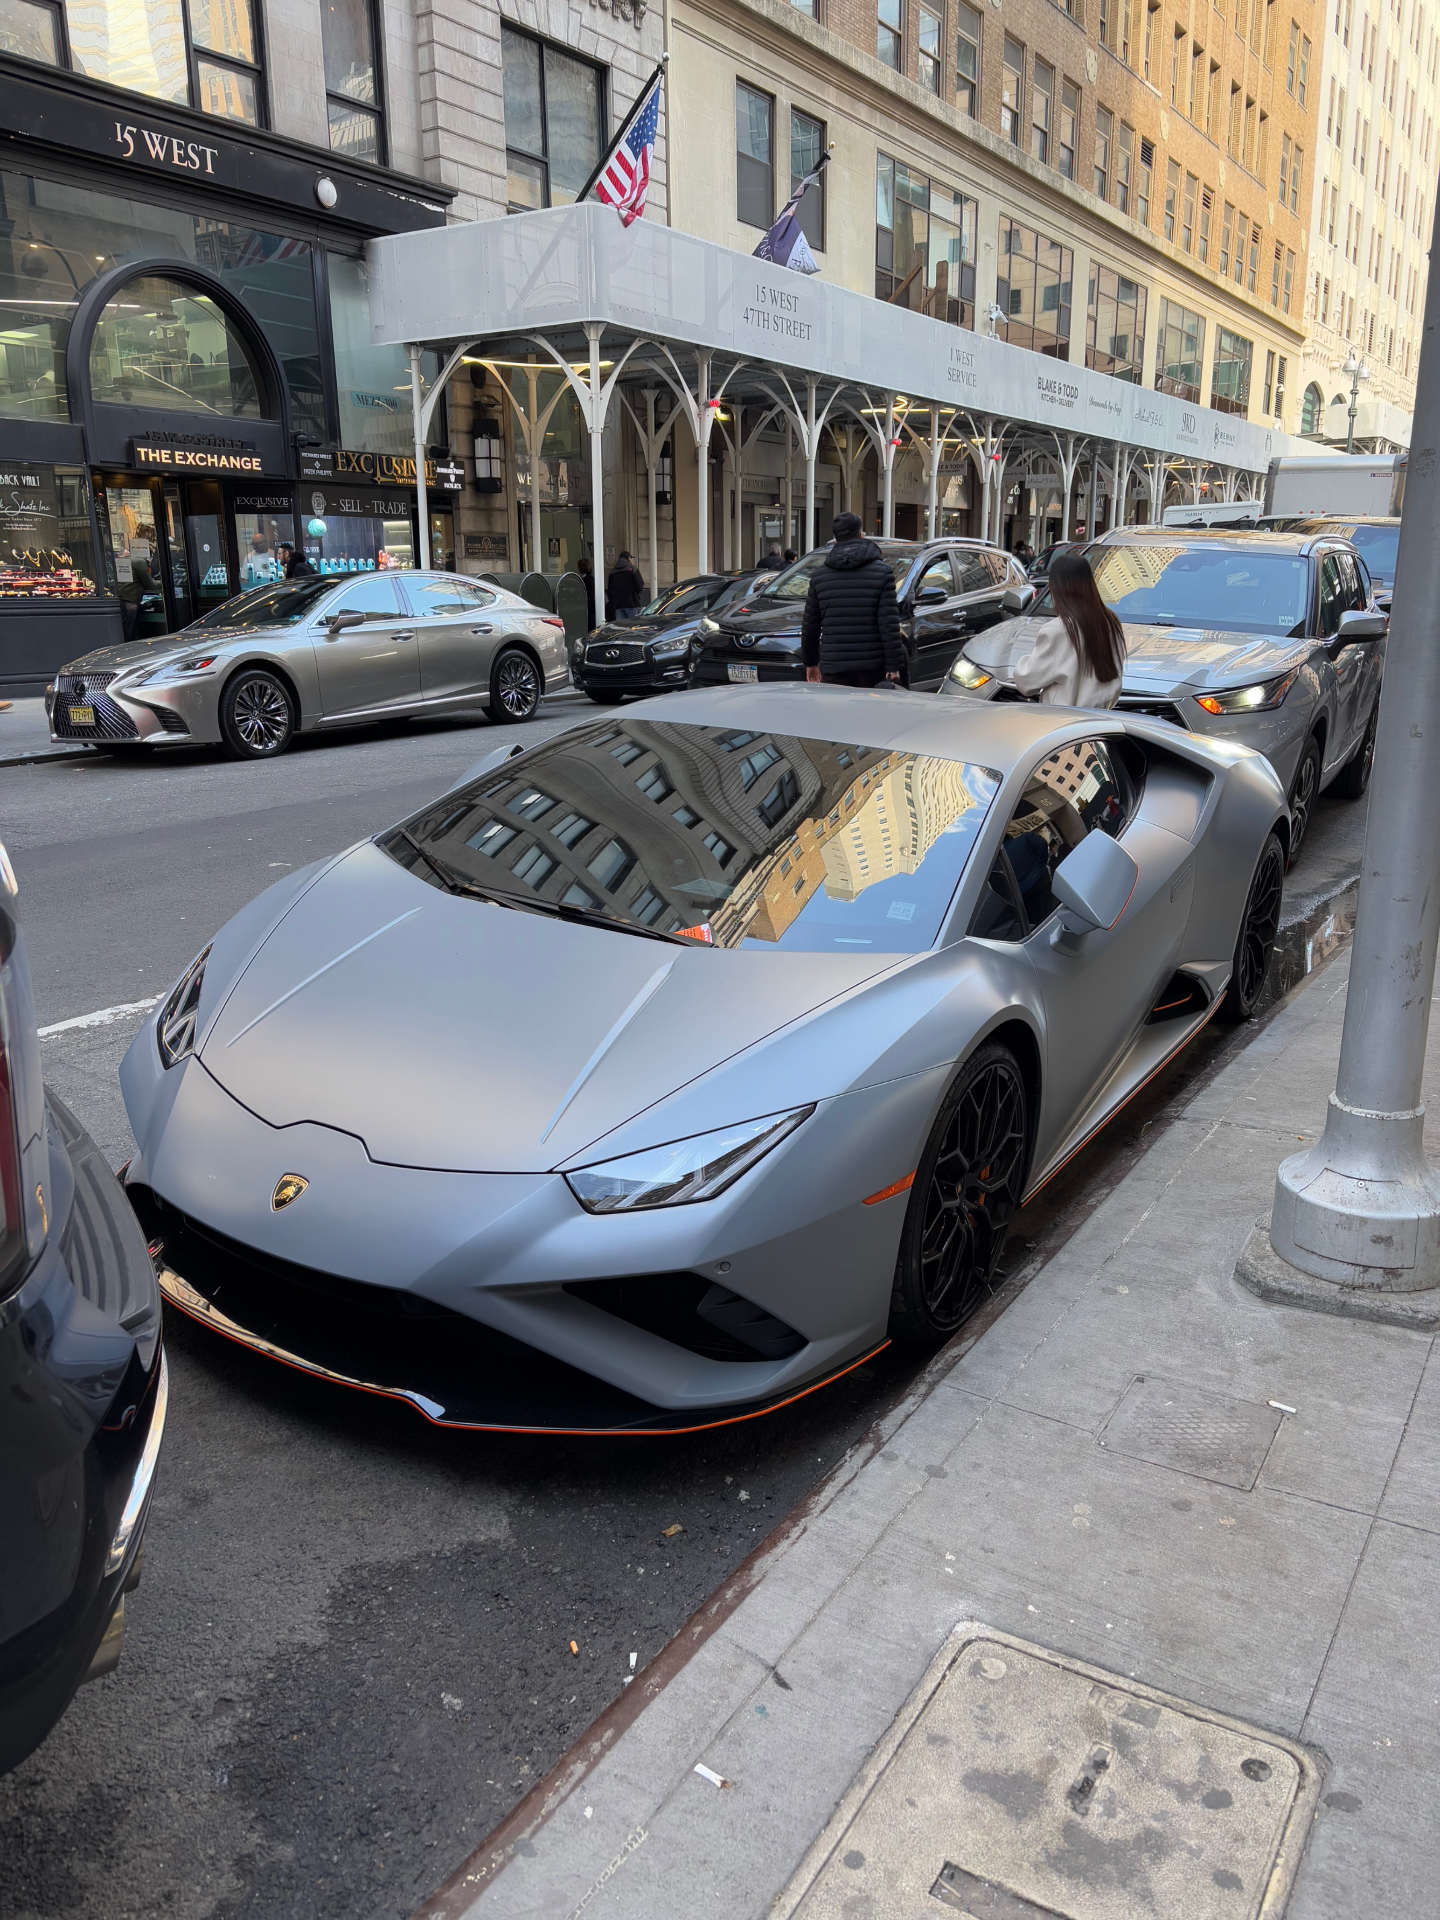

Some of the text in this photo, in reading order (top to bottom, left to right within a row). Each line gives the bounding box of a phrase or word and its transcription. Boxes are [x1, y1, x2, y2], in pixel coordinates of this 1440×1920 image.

[114, 122, 219, 175] 15 WEST
[756, 284, 800, 313] 15 WEST
[742, 306, 813, 341] 47TH STREET
[955, 348, 975, 367] WEST
[947, 366, 978, 388] SERVICE
[1037, 376, 1079, 400] BLAKE & TODD
[136, 447, 262, 471] THE EXCHANGE
[20, 475, 40, 487] VAULT
[443, 482, 463, 490] ROLEX
[236, 496, 289, 508] EXCLUSIVE
[339, 498, 363, 513] SELL
[371, 500, 408, 515] TRADE
[974, 1053, 992, 1072] ZERO
